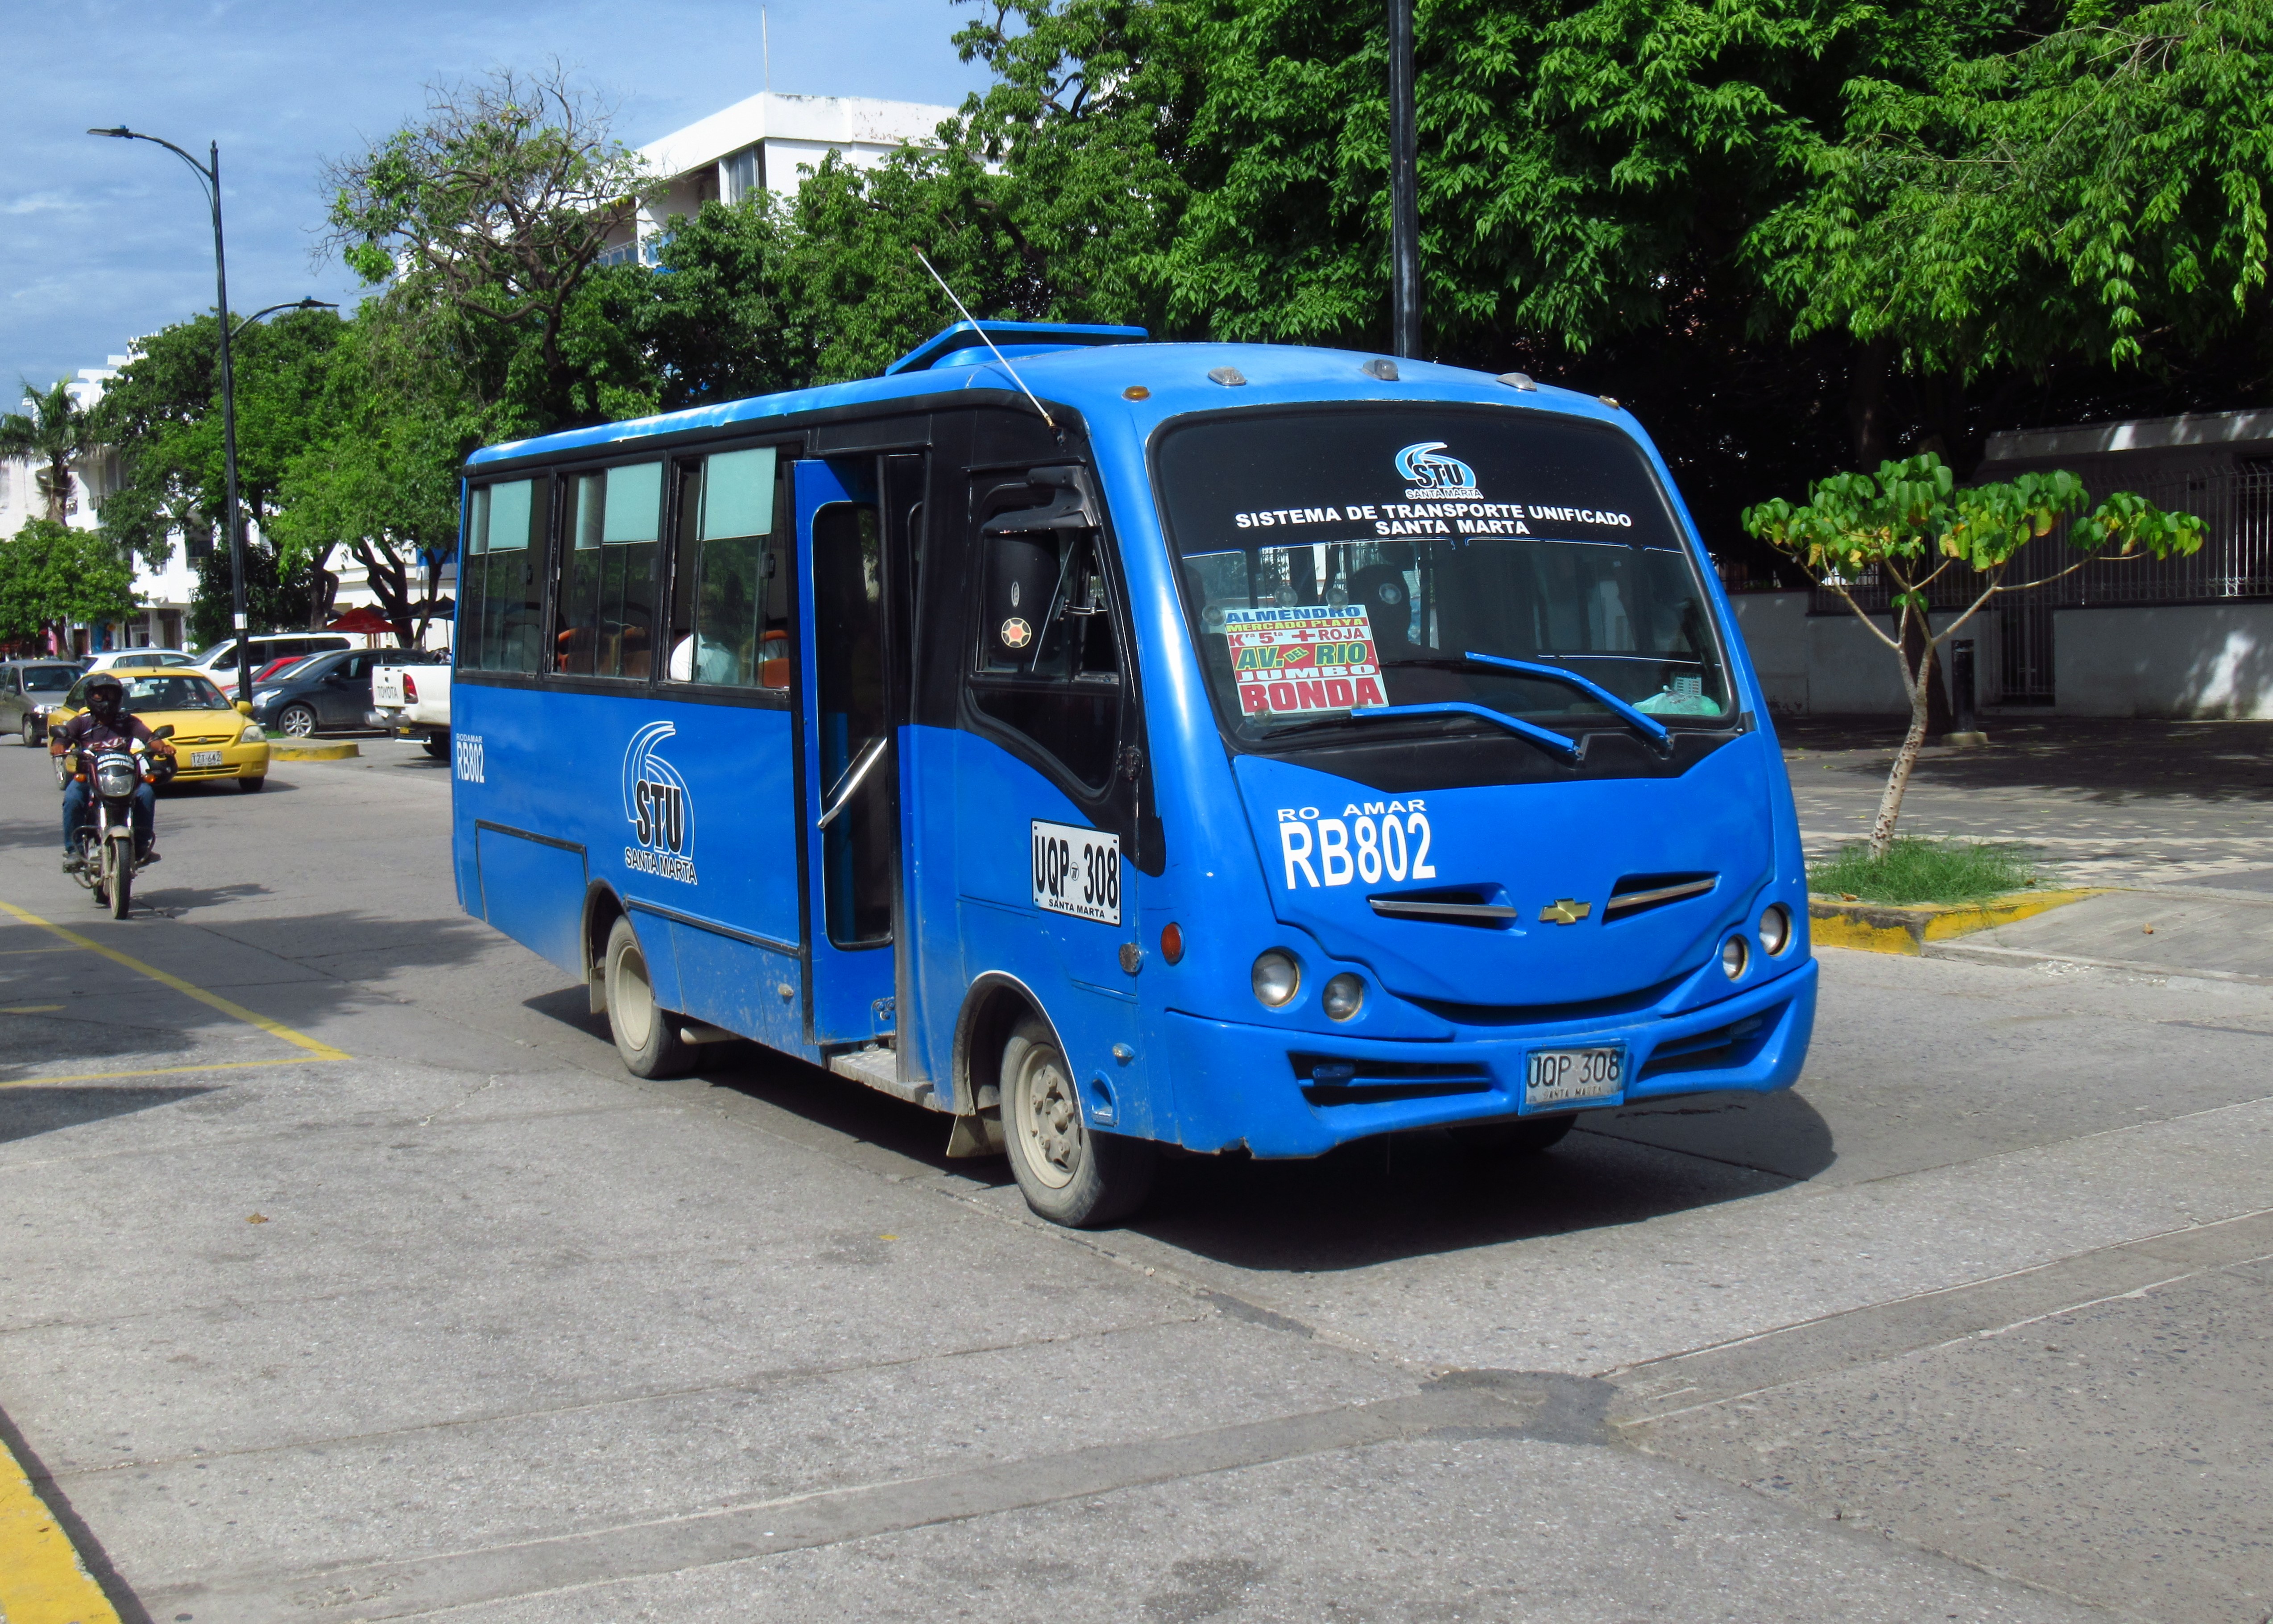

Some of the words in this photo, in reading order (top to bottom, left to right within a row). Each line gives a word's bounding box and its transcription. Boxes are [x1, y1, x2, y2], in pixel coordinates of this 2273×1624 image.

[1412, 463, 1464, 487] STU
[1406, 489, 1445, 499] SANTA
[1444, 489, 1483, 499] MARTA
[1235, 507, 1342, 528] SISTEMA
[1345, 505, 1378, 520] DE
[1382, 503, 1525, 519] TRANSPORTE
[1528, 505, 1632, 527] UNIFICADO
[1375, 519, 1451, 535] SANTA
[1456, 519, 1530, 534] MARTA
[1226, 620, 1307, 632] MERCADO
[1311, 618, 1364, 628] PLAYA
[1227, 606, 1361, 623] ALMENDRO
[1318, 627, 1365, 641] ROJA
[1236, 646, 1284, 671] AV.
[1286, 648, 1308, 662] DEL
[1315, 641, 1367, 666] RIO
[1239, 664, 1376, 682] JUMBO
[377, 686, 398, 699] TOYOTA
[1239, 677, 1385, 713] BONDA
[456, 733, 483, 744] RODAMAR
[457, 741, 485, 783] RB802
[637, 779, 682, 853] STU
[1279, 812, 1436, 890] RB802
[625, 847, 659, 875] SANTA
[658, 855, 698, 886] MARTA
[1035, 835, 1069, 901] UQP
[1084, 843, 1118, 909] 308
[1049, 899, 1075, 912] SANTA
[1076, 904, 1105, 919] MARTA
[1527, 1055, 1572, 1088] UQP
[1579, 1049, 1619, 1084] 308
